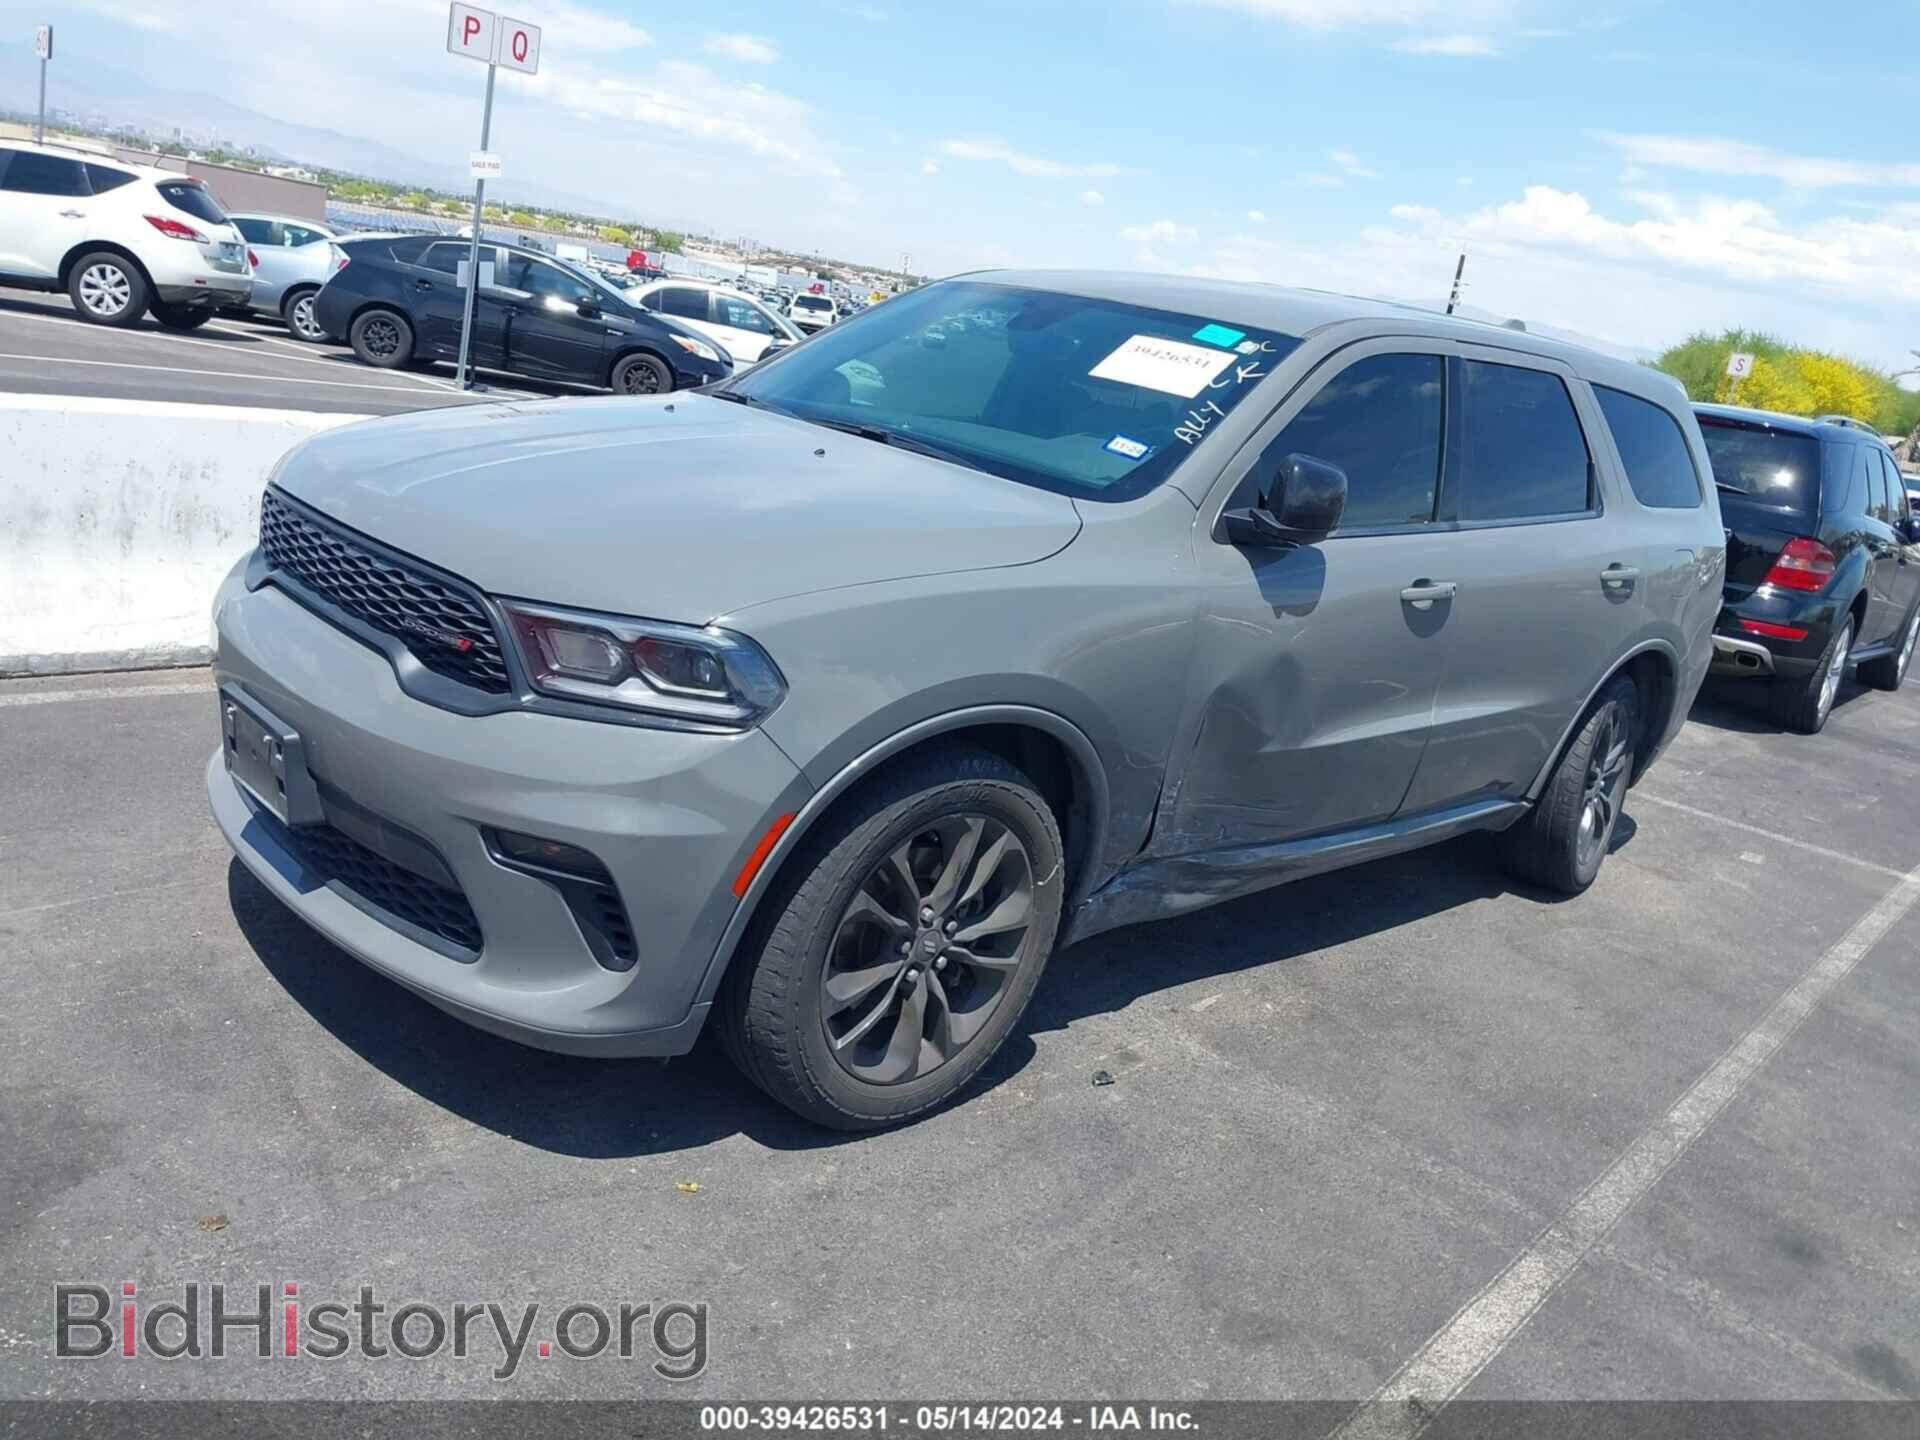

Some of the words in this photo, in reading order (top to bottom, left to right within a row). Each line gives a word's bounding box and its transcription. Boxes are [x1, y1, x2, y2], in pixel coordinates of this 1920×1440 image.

[464, 15, 481, 46] P
[512, 30, 528, 62] Q
[1735, 358, 1745, 372] S
[1173, 400, 1225, 445] ALLY
